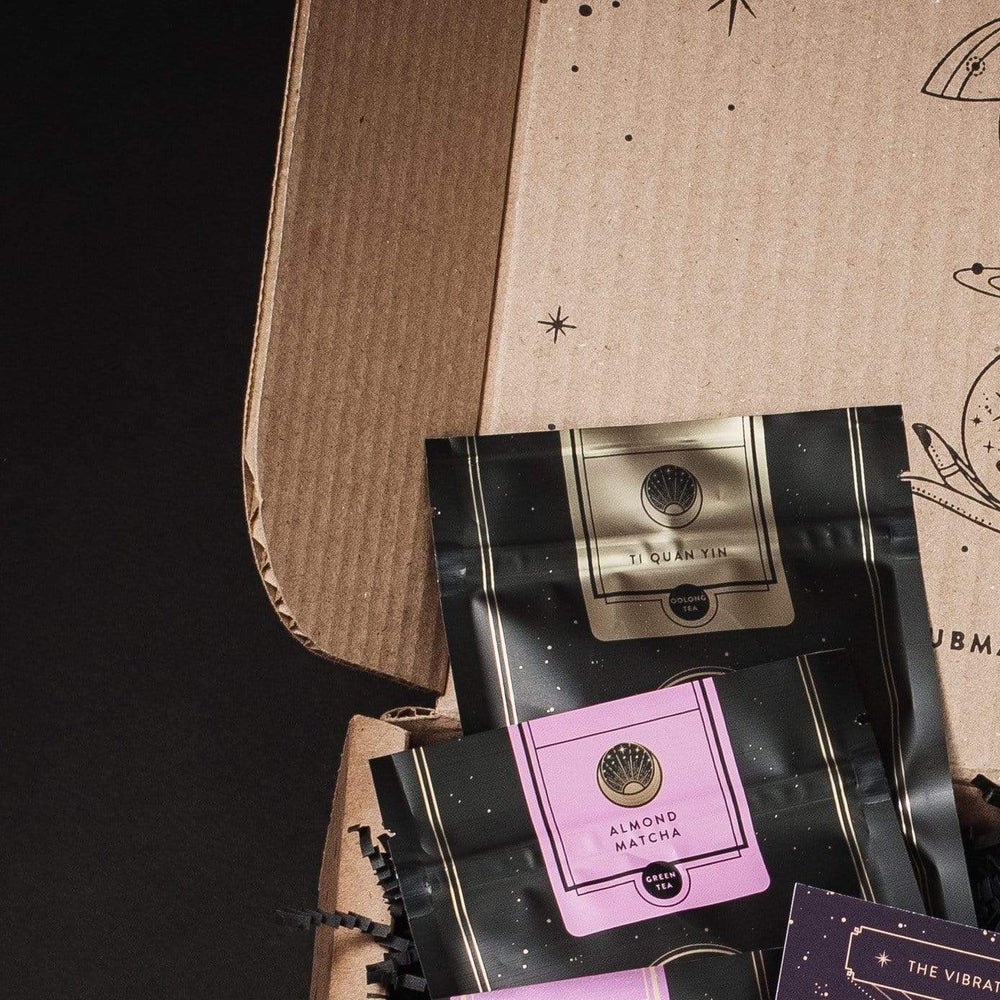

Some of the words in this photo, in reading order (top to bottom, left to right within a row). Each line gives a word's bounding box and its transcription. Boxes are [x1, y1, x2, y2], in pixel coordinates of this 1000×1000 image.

[629, 553, 643, 565] TI
[650, 549, 695, 565] QUAN
[700, 547, 728, 559] YIN
[670, 594, 707, 605] OOLONG
[683, 605, 698, 613] TEA
[609, 811, 677, 836] ALMOND
[615, 827, 682, 852] MATCHA
[645, 871, 676, 883] GREEN
[655, 882, 673, 891] TEA
[908, 959, 938, 979] THE
